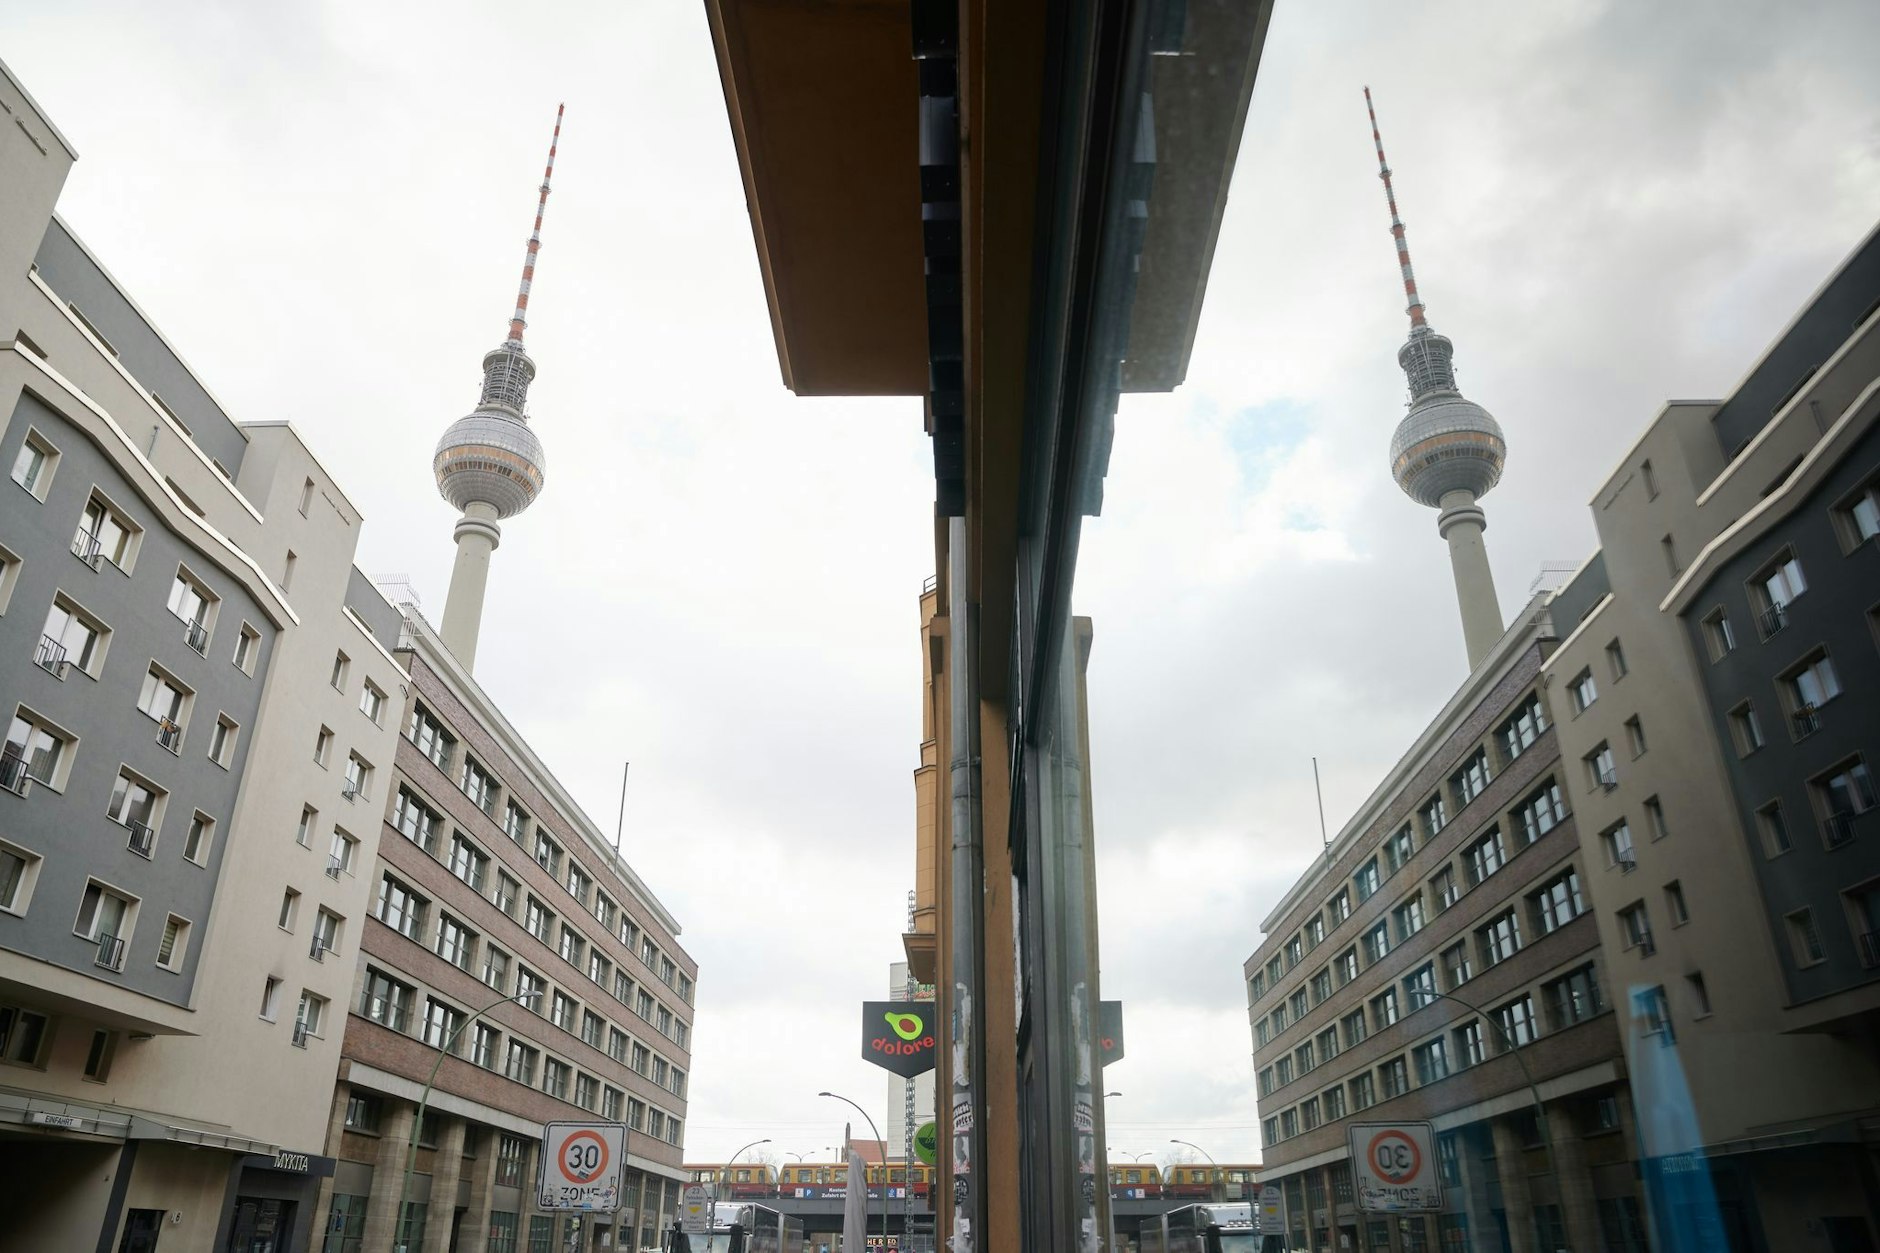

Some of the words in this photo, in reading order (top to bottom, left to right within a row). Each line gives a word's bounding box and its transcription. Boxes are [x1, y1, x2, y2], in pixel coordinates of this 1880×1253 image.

[45, 1115, 74, 1126] EINFAHRT
[273, 1153, 308, 1172] MYKITA
[568, 1145, 599, 1169] 30
